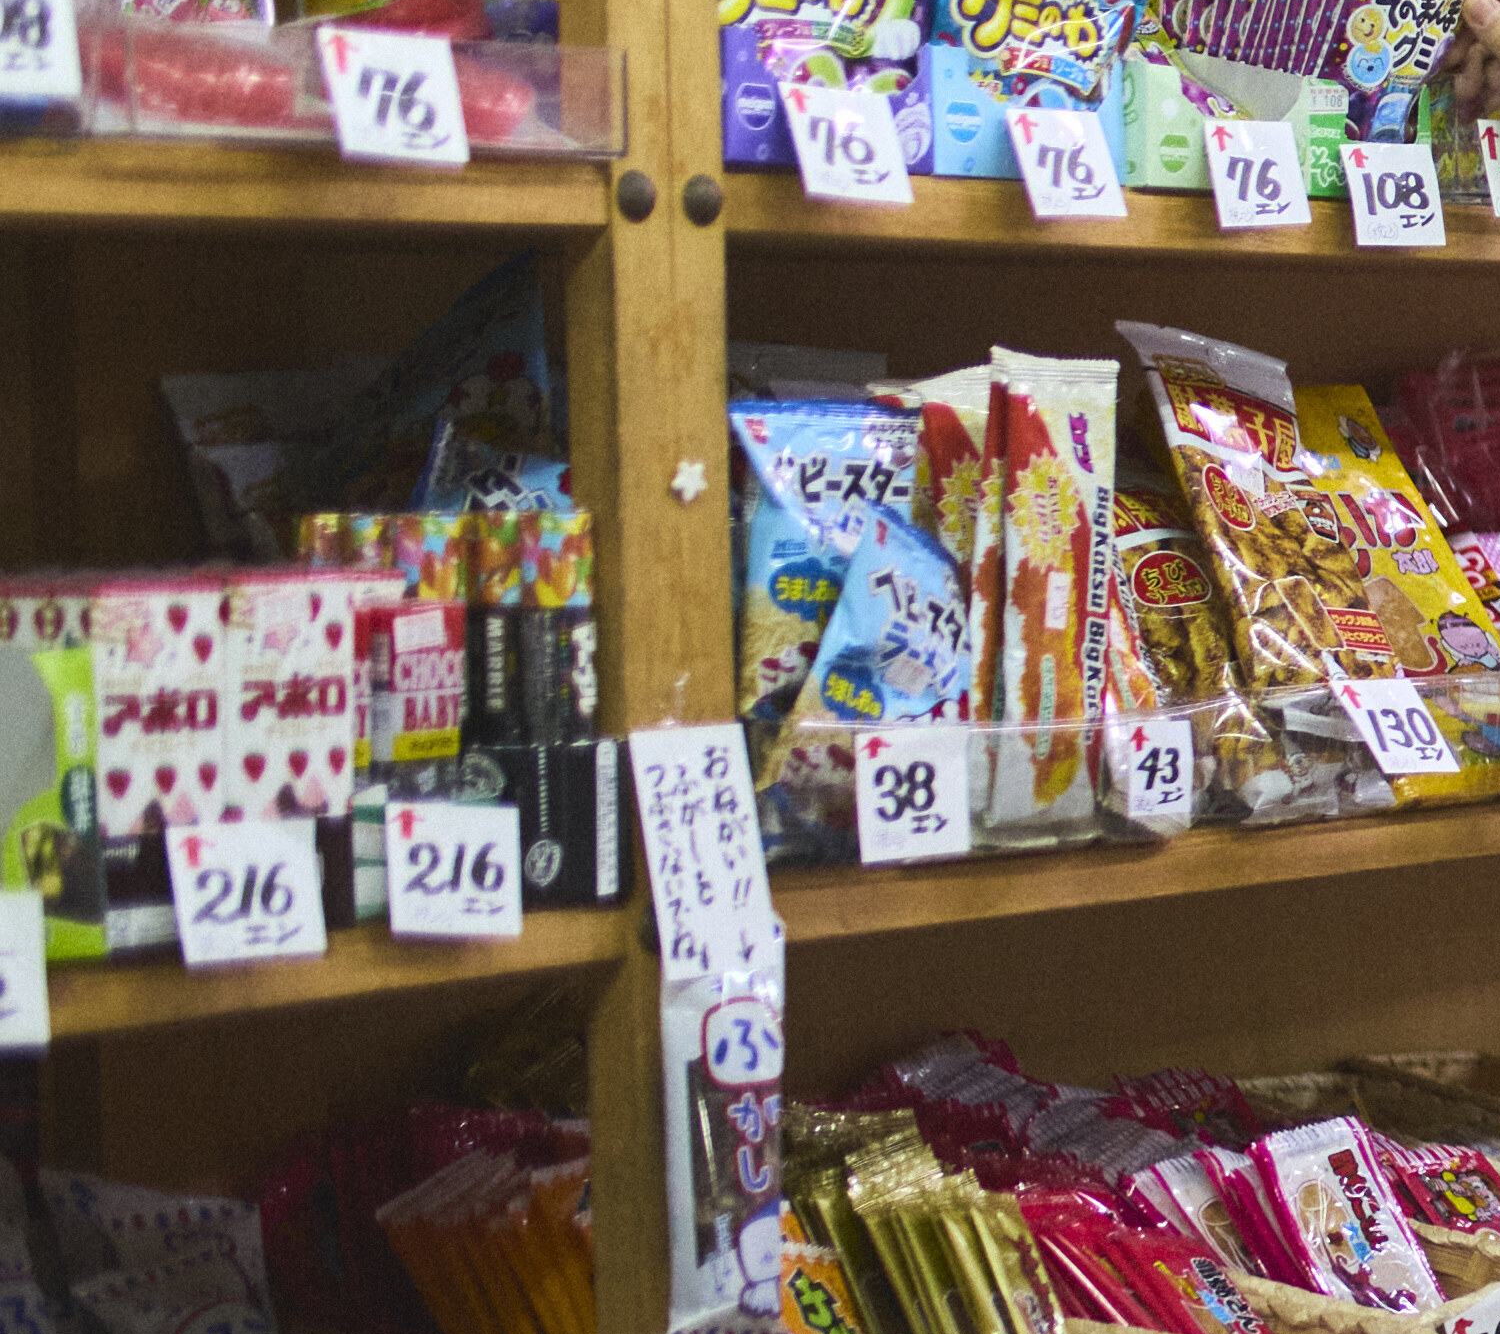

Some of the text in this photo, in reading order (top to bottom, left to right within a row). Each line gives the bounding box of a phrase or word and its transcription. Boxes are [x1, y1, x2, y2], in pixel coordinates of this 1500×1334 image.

[1393, 33, 1438, 72] グミ
[358, 68, 435, 130] 76
[1036, 143, 1094, 188] 76
[1227, 154, 1281, 198] 76
[1362, 172, 1435, 228] 108 エン
[103, 687, 219, 737] アポロ
[241, 674, 348, 721] アポロ
[402, 697, 461, 731] BABY
[1367, 706, 1446, 763] 130 エン
[876, 762, 936, 822] 38
[1136, 747, 1180, 791] 43
[404, 841, 506, 896] 216
[191, 864, 300, 946] 216 エン
